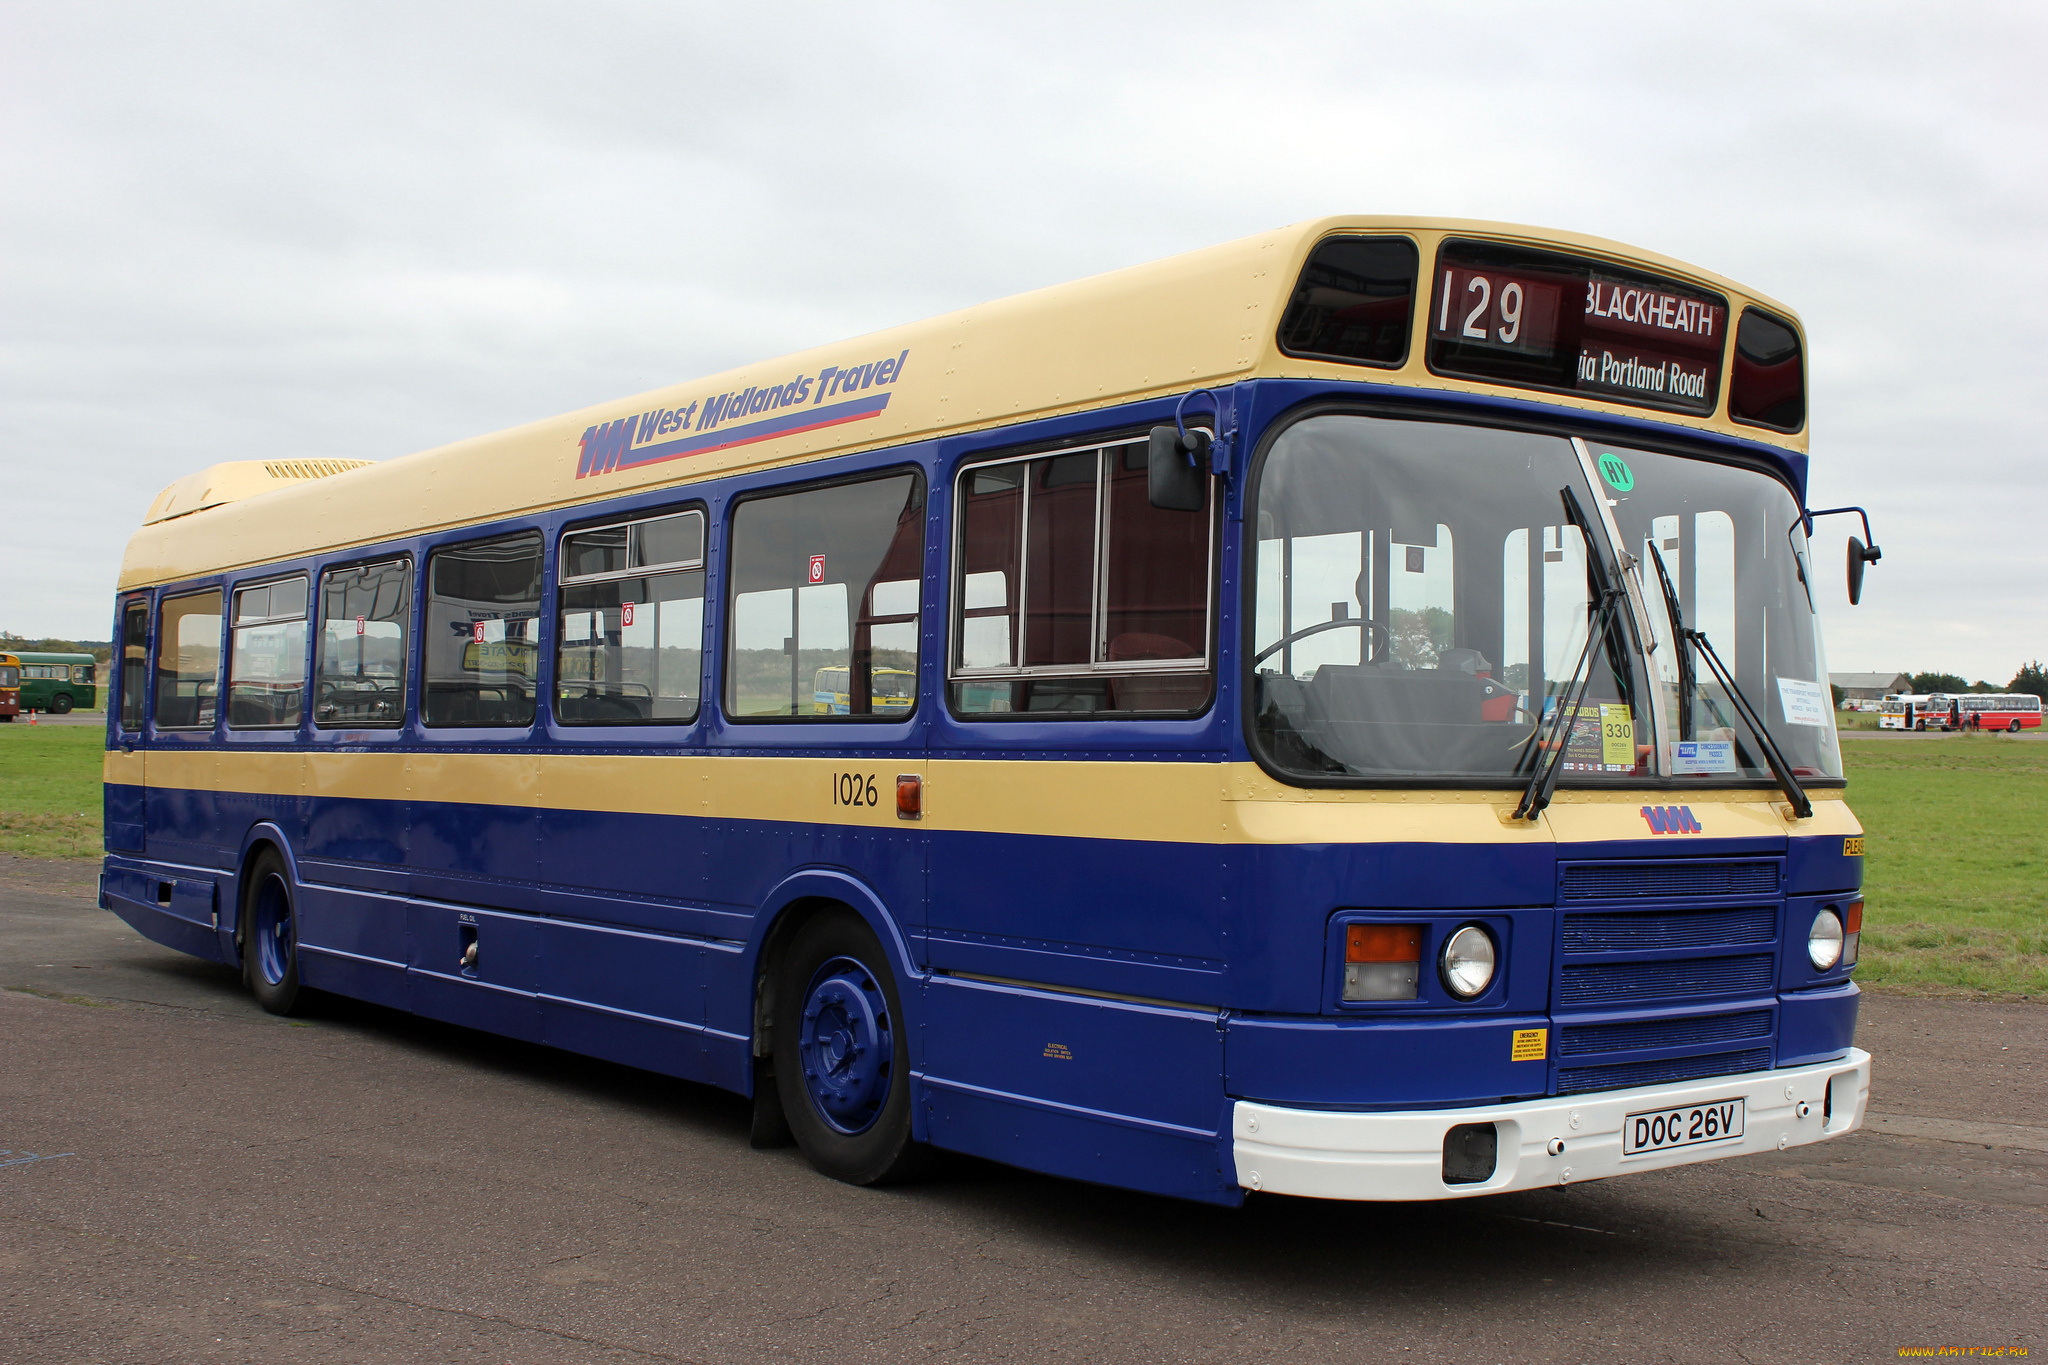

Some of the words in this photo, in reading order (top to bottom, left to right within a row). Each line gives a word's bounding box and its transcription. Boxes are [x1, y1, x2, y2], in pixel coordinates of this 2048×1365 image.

[1440, 270, 1523, 343] 129
[1585, 281, 1713, 336] BLACKHEATH
[635, 399, 698, 445] West
[695, 374, 814, 432] Midlands
[813, 349, 910, 405] Travel
[1601, 350, 1665, 392] Portland
[1669, 361, 1706, 398] Road
[1606, 723, 1630, 738] 330
[833, 772, 878, 807] 1026
[1635, 1111, 1681, 1148] DOC
[1688, 1104, 1734, 1139] 26V
